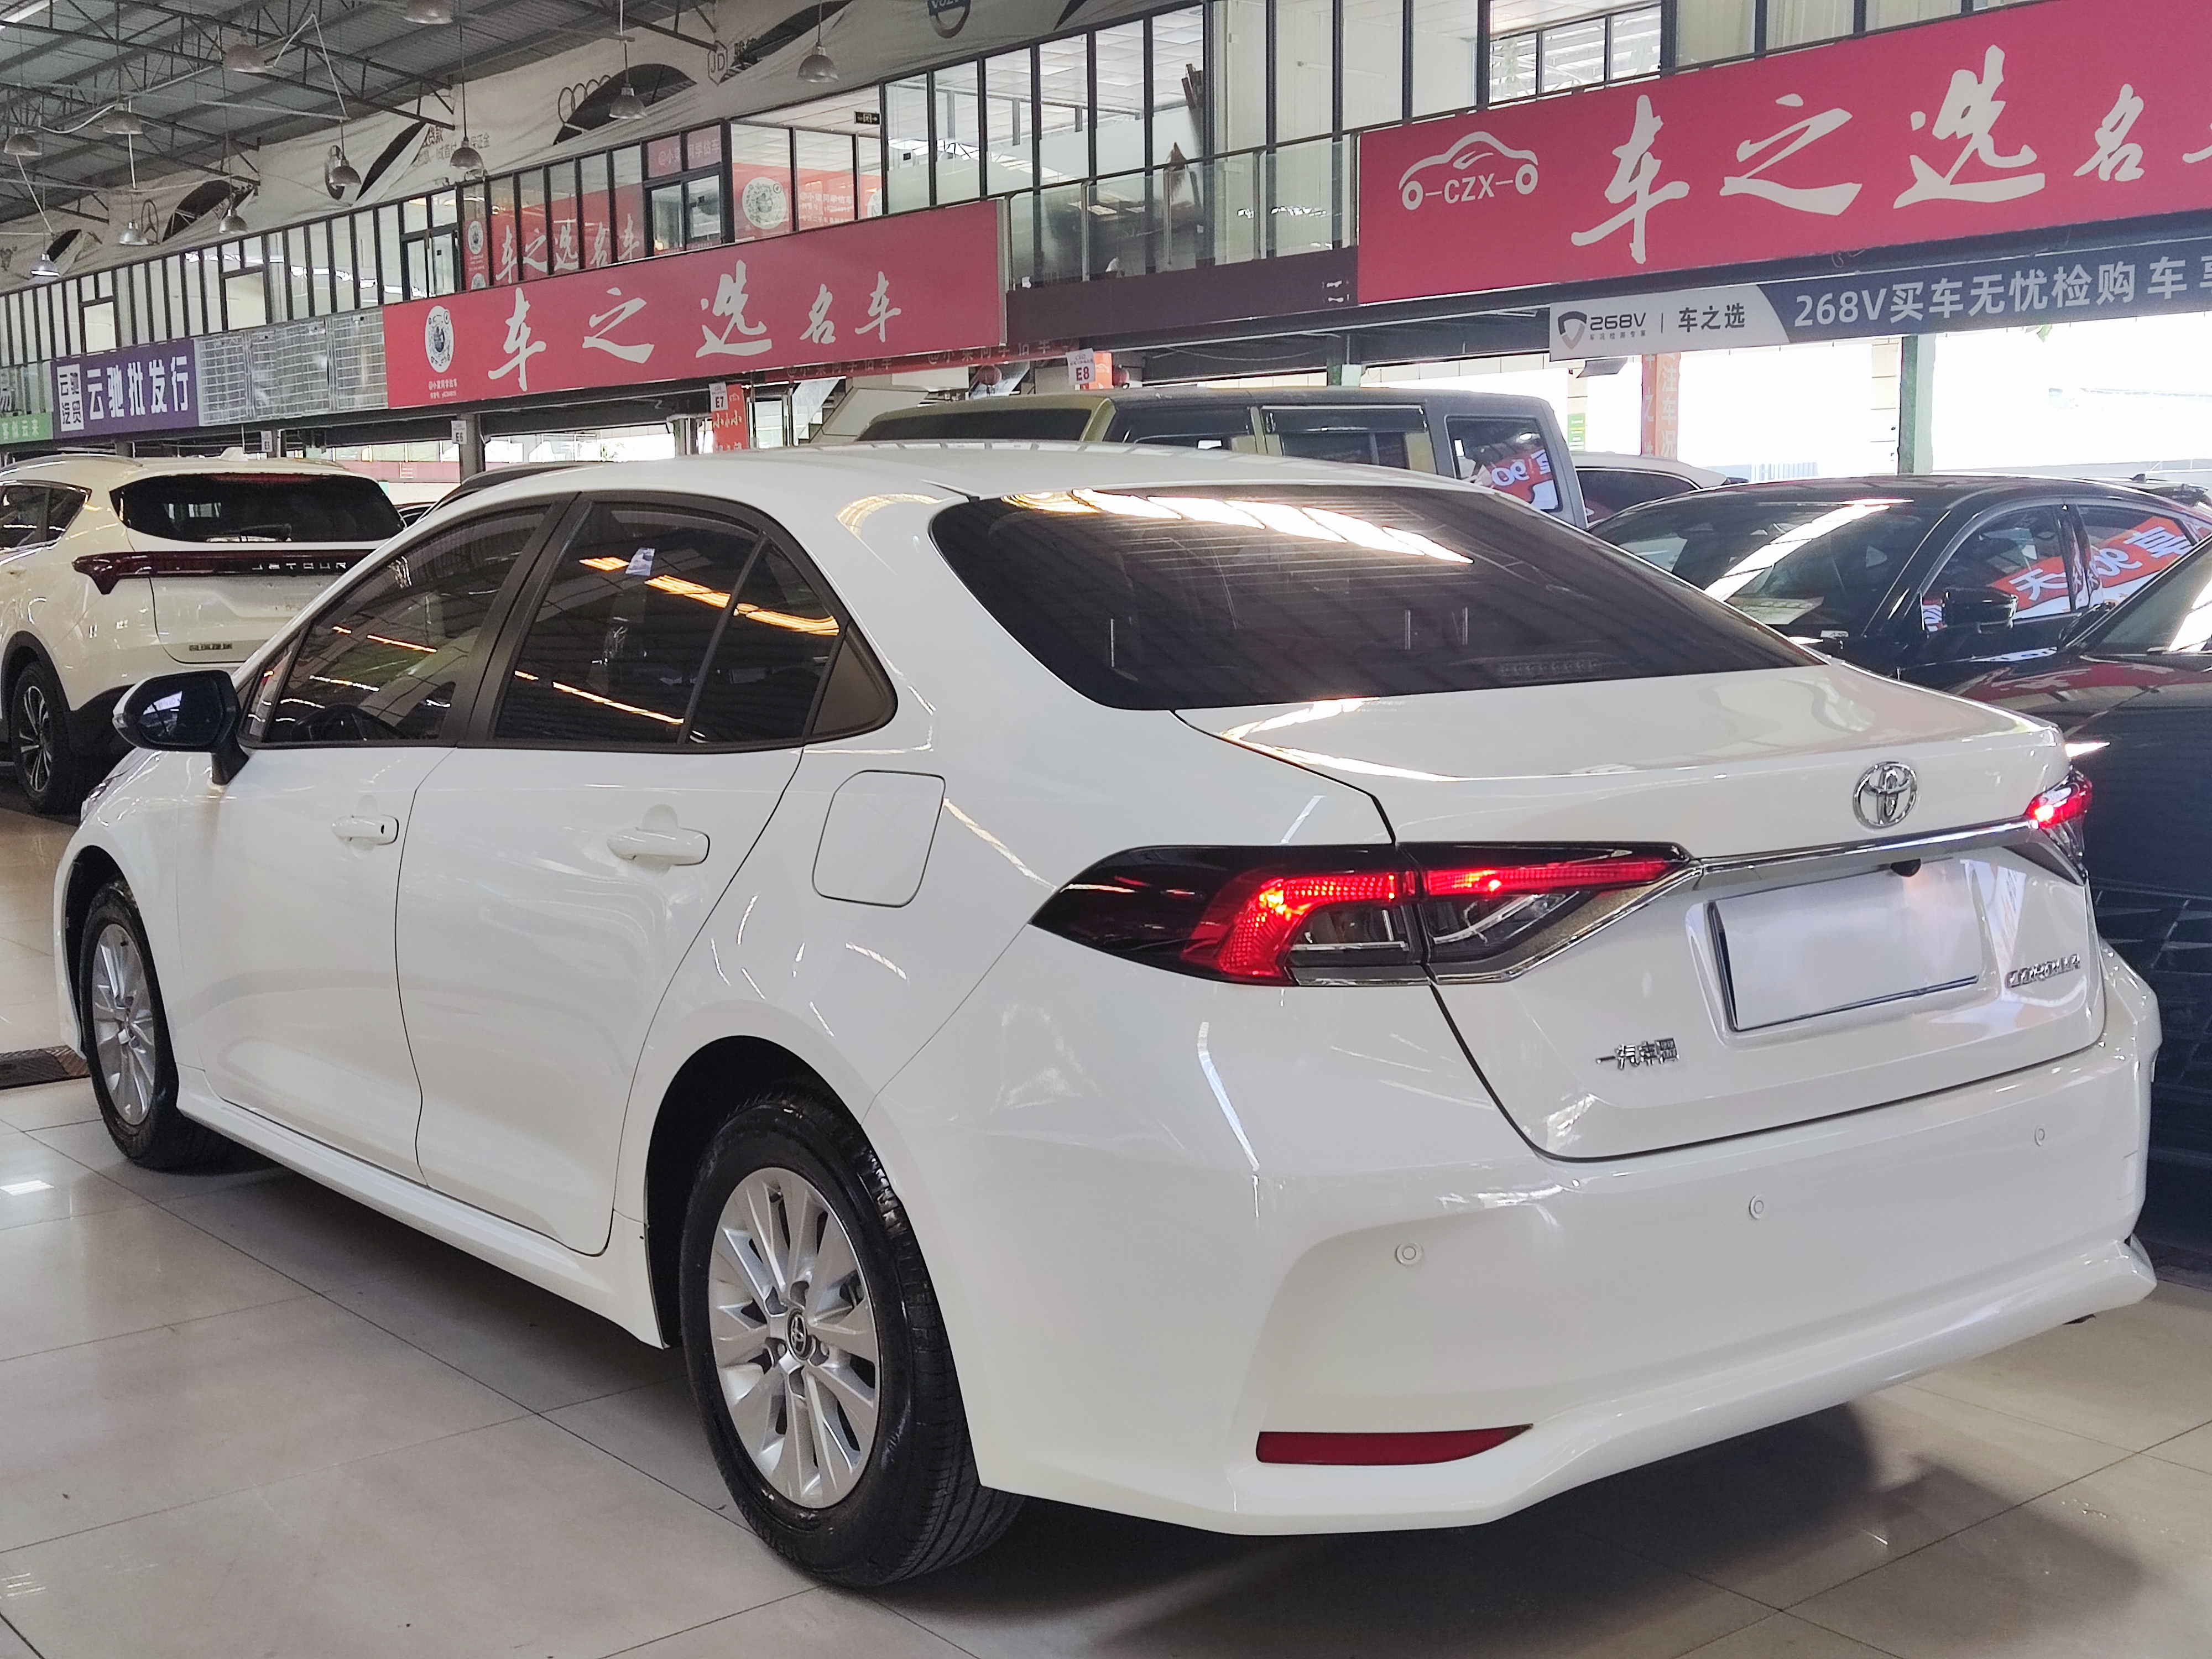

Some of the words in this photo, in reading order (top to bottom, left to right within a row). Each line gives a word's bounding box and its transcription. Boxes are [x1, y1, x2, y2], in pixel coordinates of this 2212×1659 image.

[1572, 45, 2212, 264] 车之选名
[488, 259, 901, 392] 车之选名车
[1590, 312, 1646, 331] 268V
[1678, 302, 1745, 333] 车之选
[86, 356, 189, 421] 云驰批发行
[1076, 366, 1089, 382] E8
[716, 396, 724, 408] E7
[456, 432, 463, 442] E6
